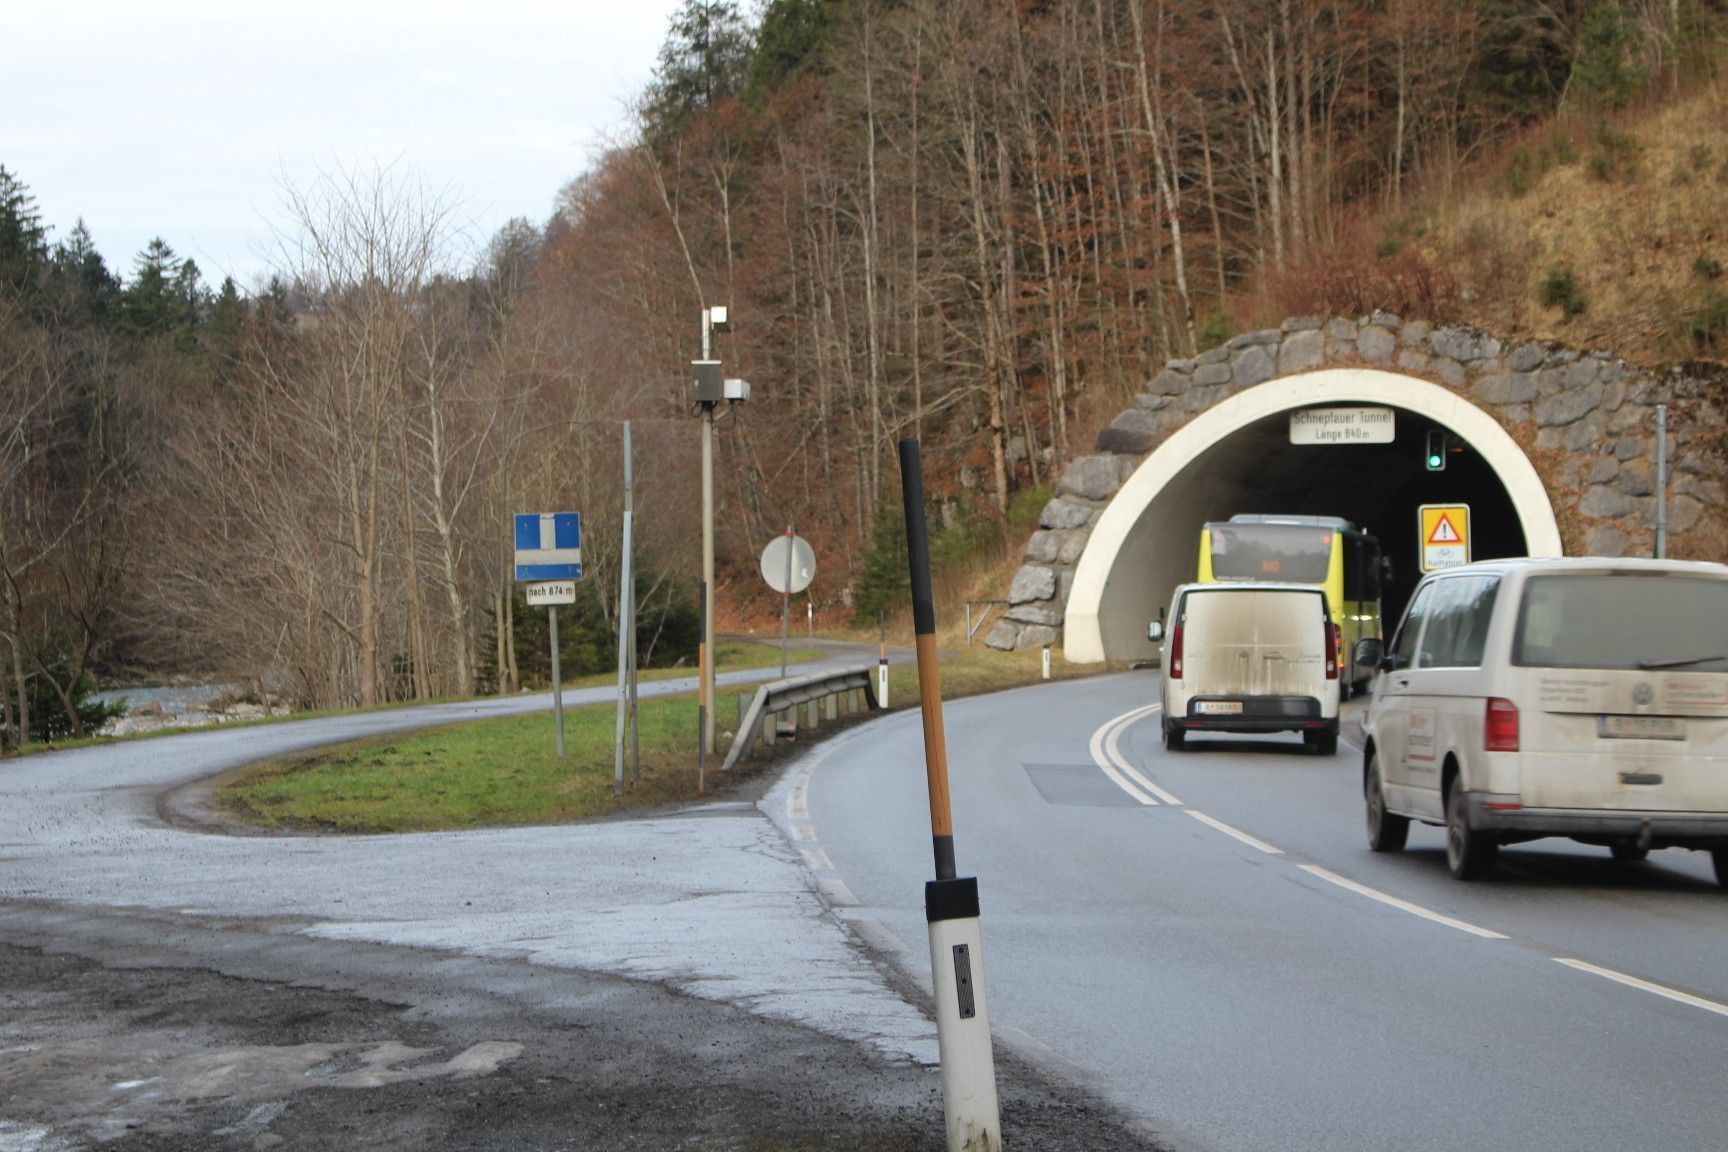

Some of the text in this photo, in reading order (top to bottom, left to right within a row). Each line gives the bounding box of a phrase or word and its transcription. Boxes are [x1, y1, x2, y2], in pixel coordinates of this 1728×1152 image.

[1360, 410, 1392, 423] Tunnel
[529, 586, 573, 596] nach 874 m
